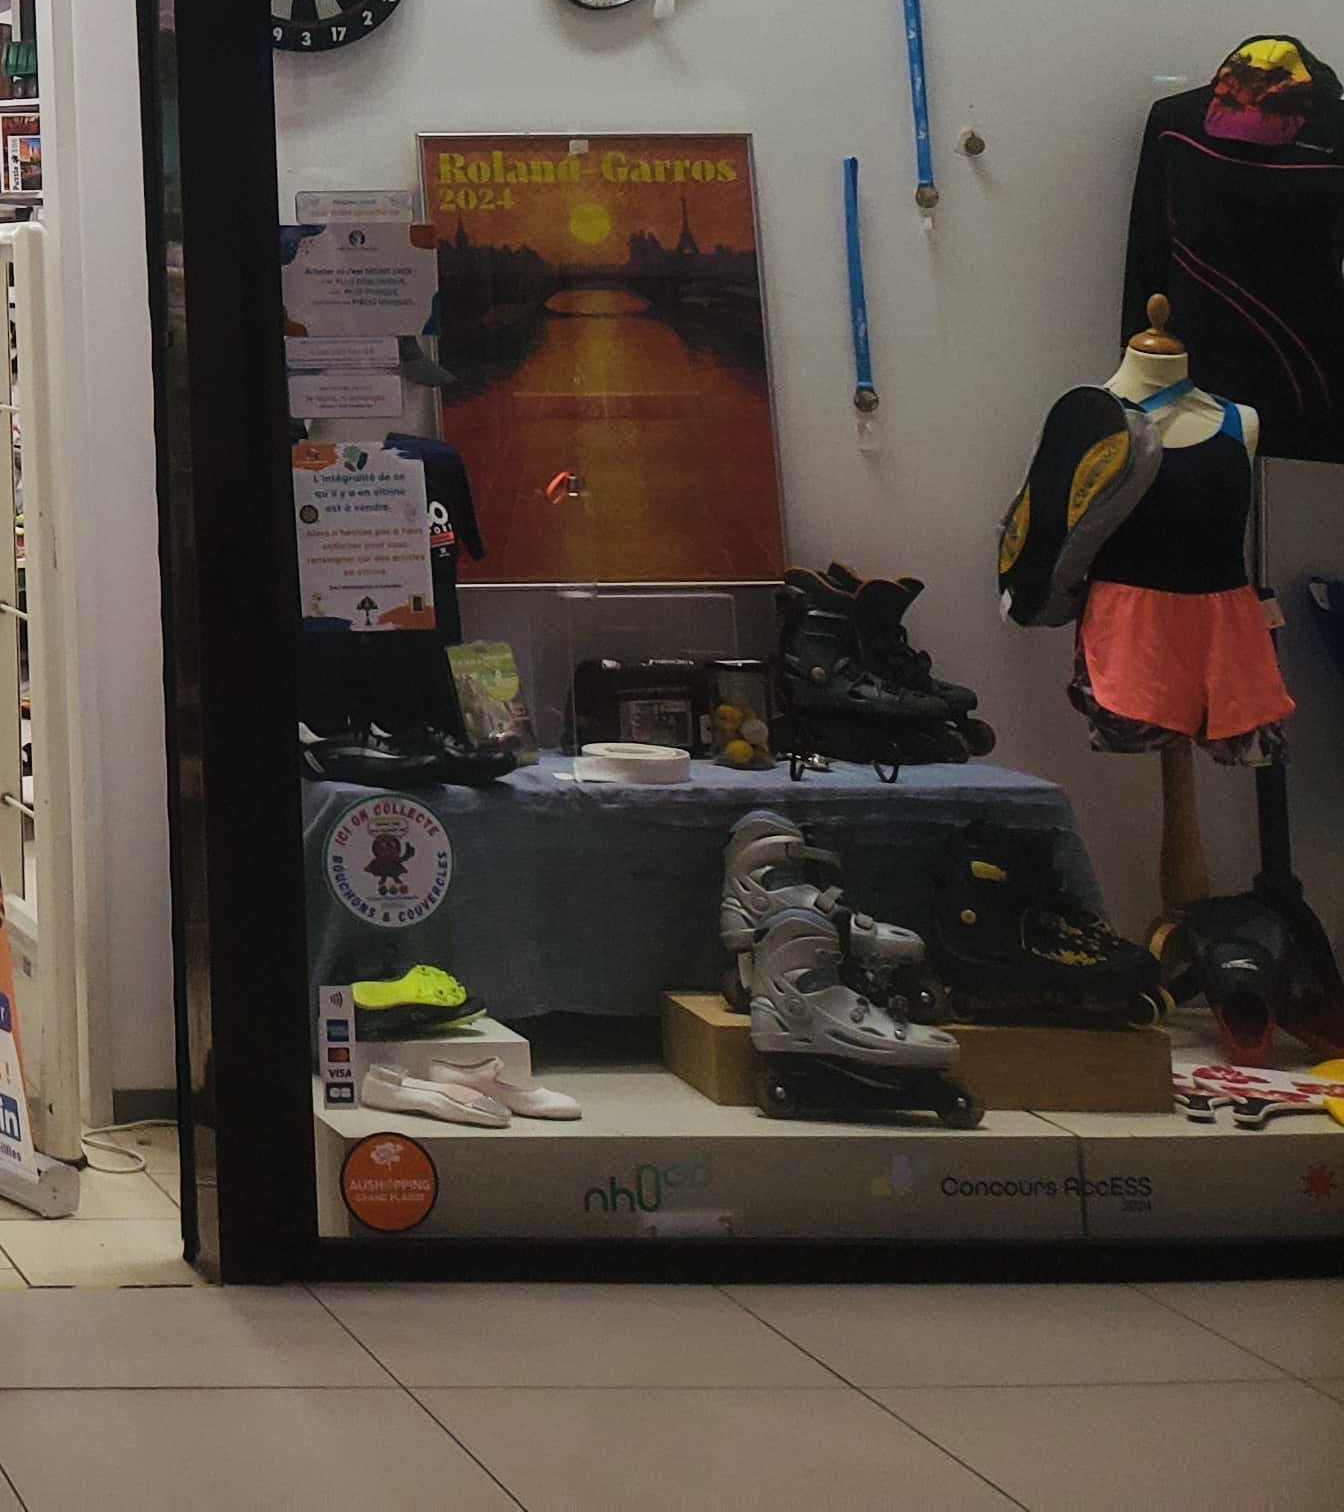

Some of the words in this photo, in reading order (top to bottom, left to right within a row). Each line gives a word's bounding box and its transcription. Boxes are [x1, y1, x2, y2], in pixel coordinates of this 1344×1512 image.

[362, 11, 373, 25] 2
[273, 27, 283, 41] 9
[301, 31, 311, 46] 3
[331, 26, 347, 41] 17
[439, 187, 514, 211] 2024
[334, 826, 352, 846] ICI
[352, 808, 369, 826] ON
[374, 802, 440, 837] COLLECTE
[332, 855, 376, 918] BOUCHONS
[398, 850, 448, 922] COUVERCLES
[328, 1068, 352, 1079] VISA
[940, 1175, 1057, 1199] Concours
[1064, 1175, 1153, 1199] AccESS
